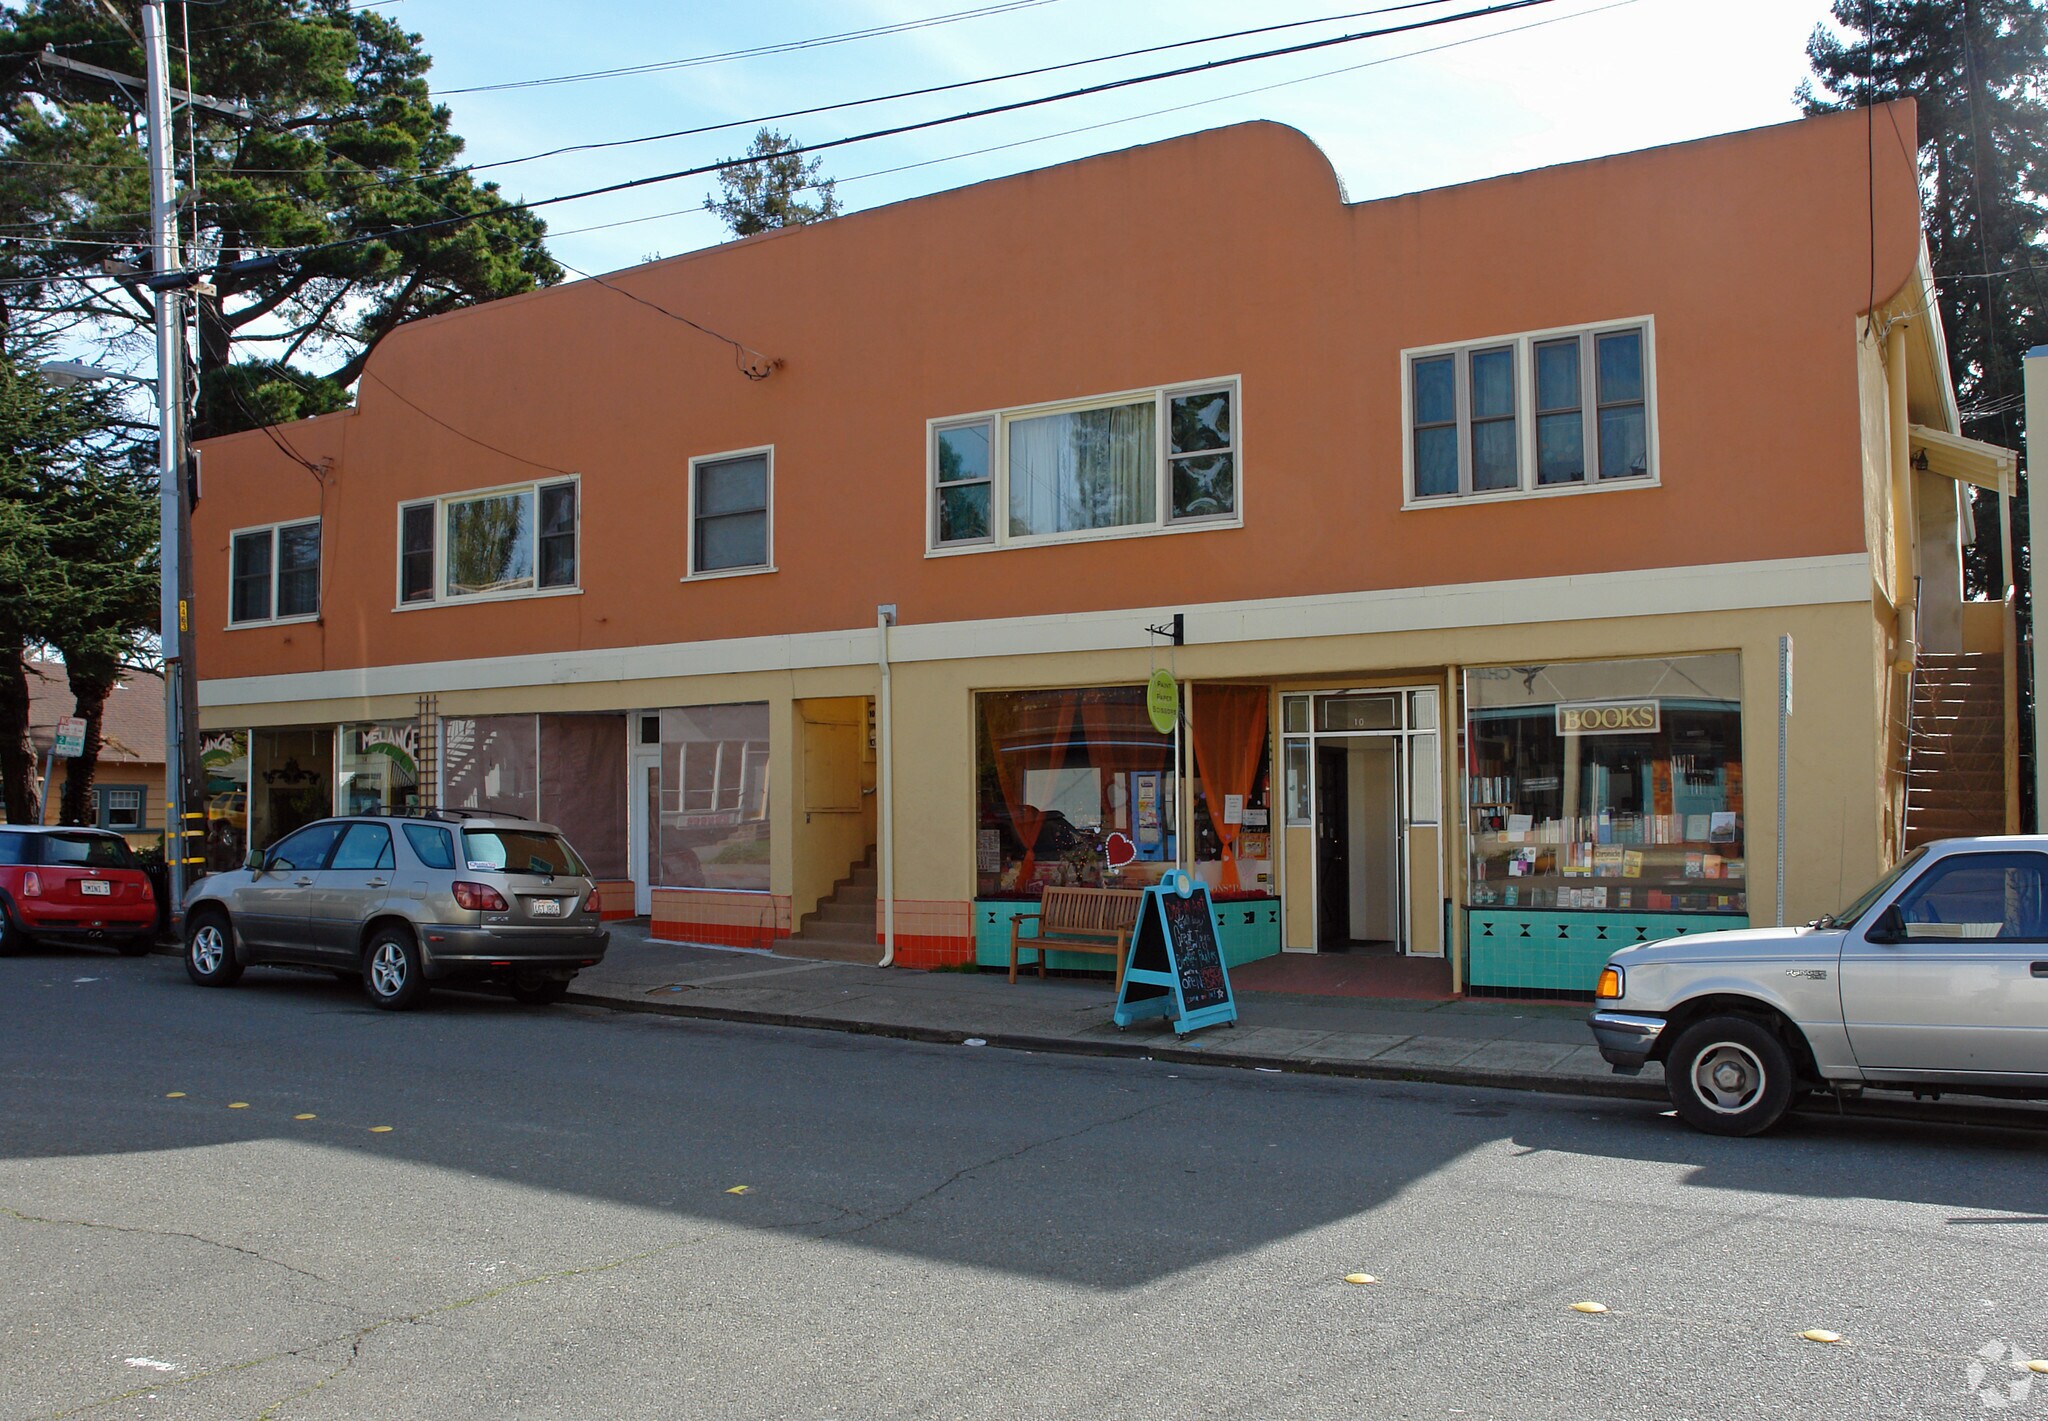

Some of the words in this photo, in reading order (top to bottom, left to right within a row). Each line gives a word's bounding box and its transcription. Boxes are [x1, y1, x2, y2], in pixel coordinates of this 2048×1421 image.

[1152, 706, 1177, 715] SCISSORS
[1563, 706, 1654, 730] BOOKS
[1354, 718, 1364, 726] 10
[200, 733, 232, 756] ANGE
